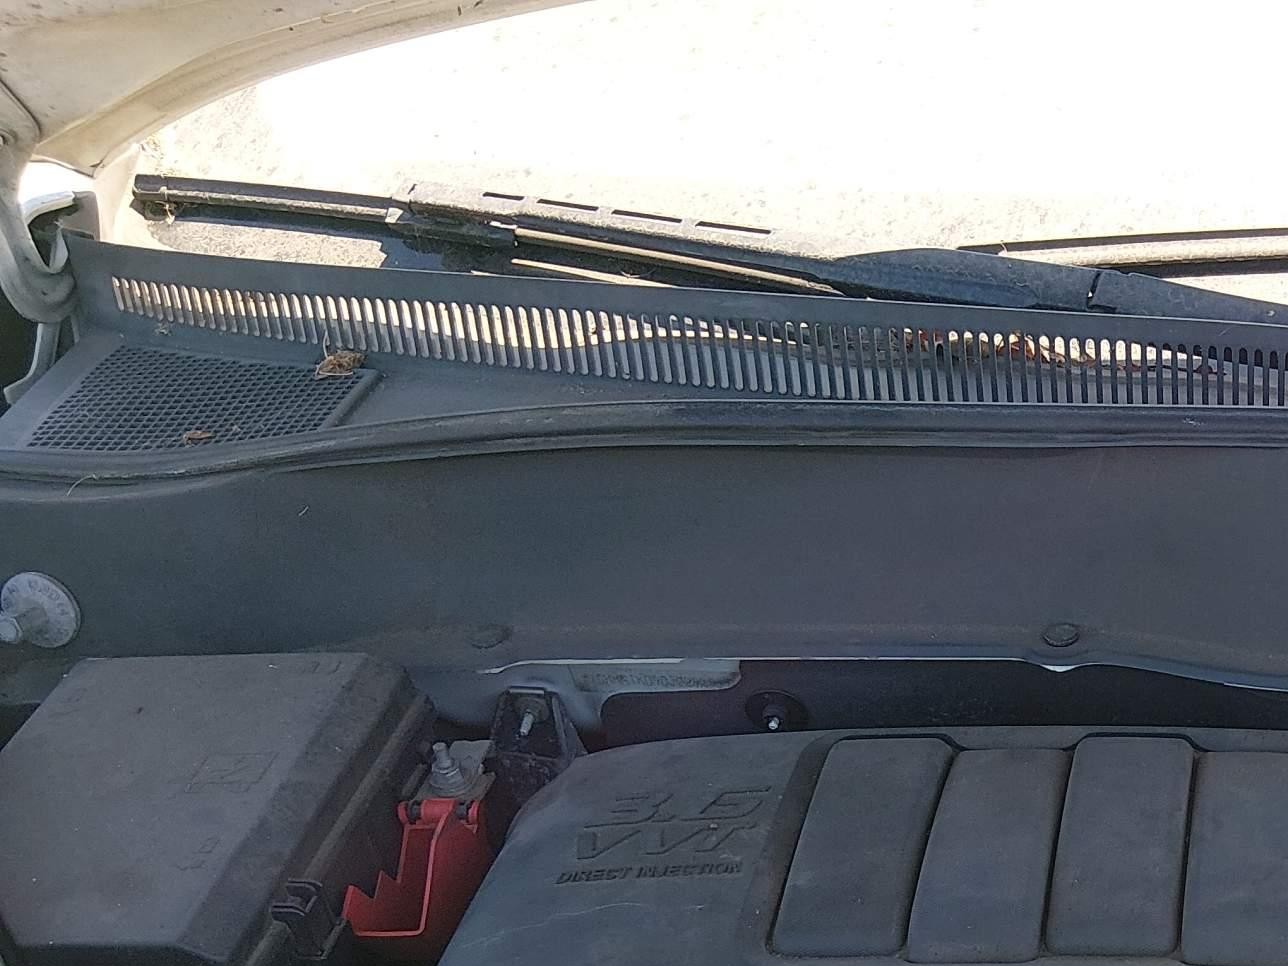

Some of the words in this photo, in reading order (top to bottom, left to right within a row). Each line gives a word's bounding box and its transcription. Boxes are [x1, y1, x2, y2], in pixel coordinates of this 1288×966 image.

[576, 823, 757, 860] VVT
[555, 867, 632, 885] DIRECT
[636, 861, 742, 879] INJECTION
